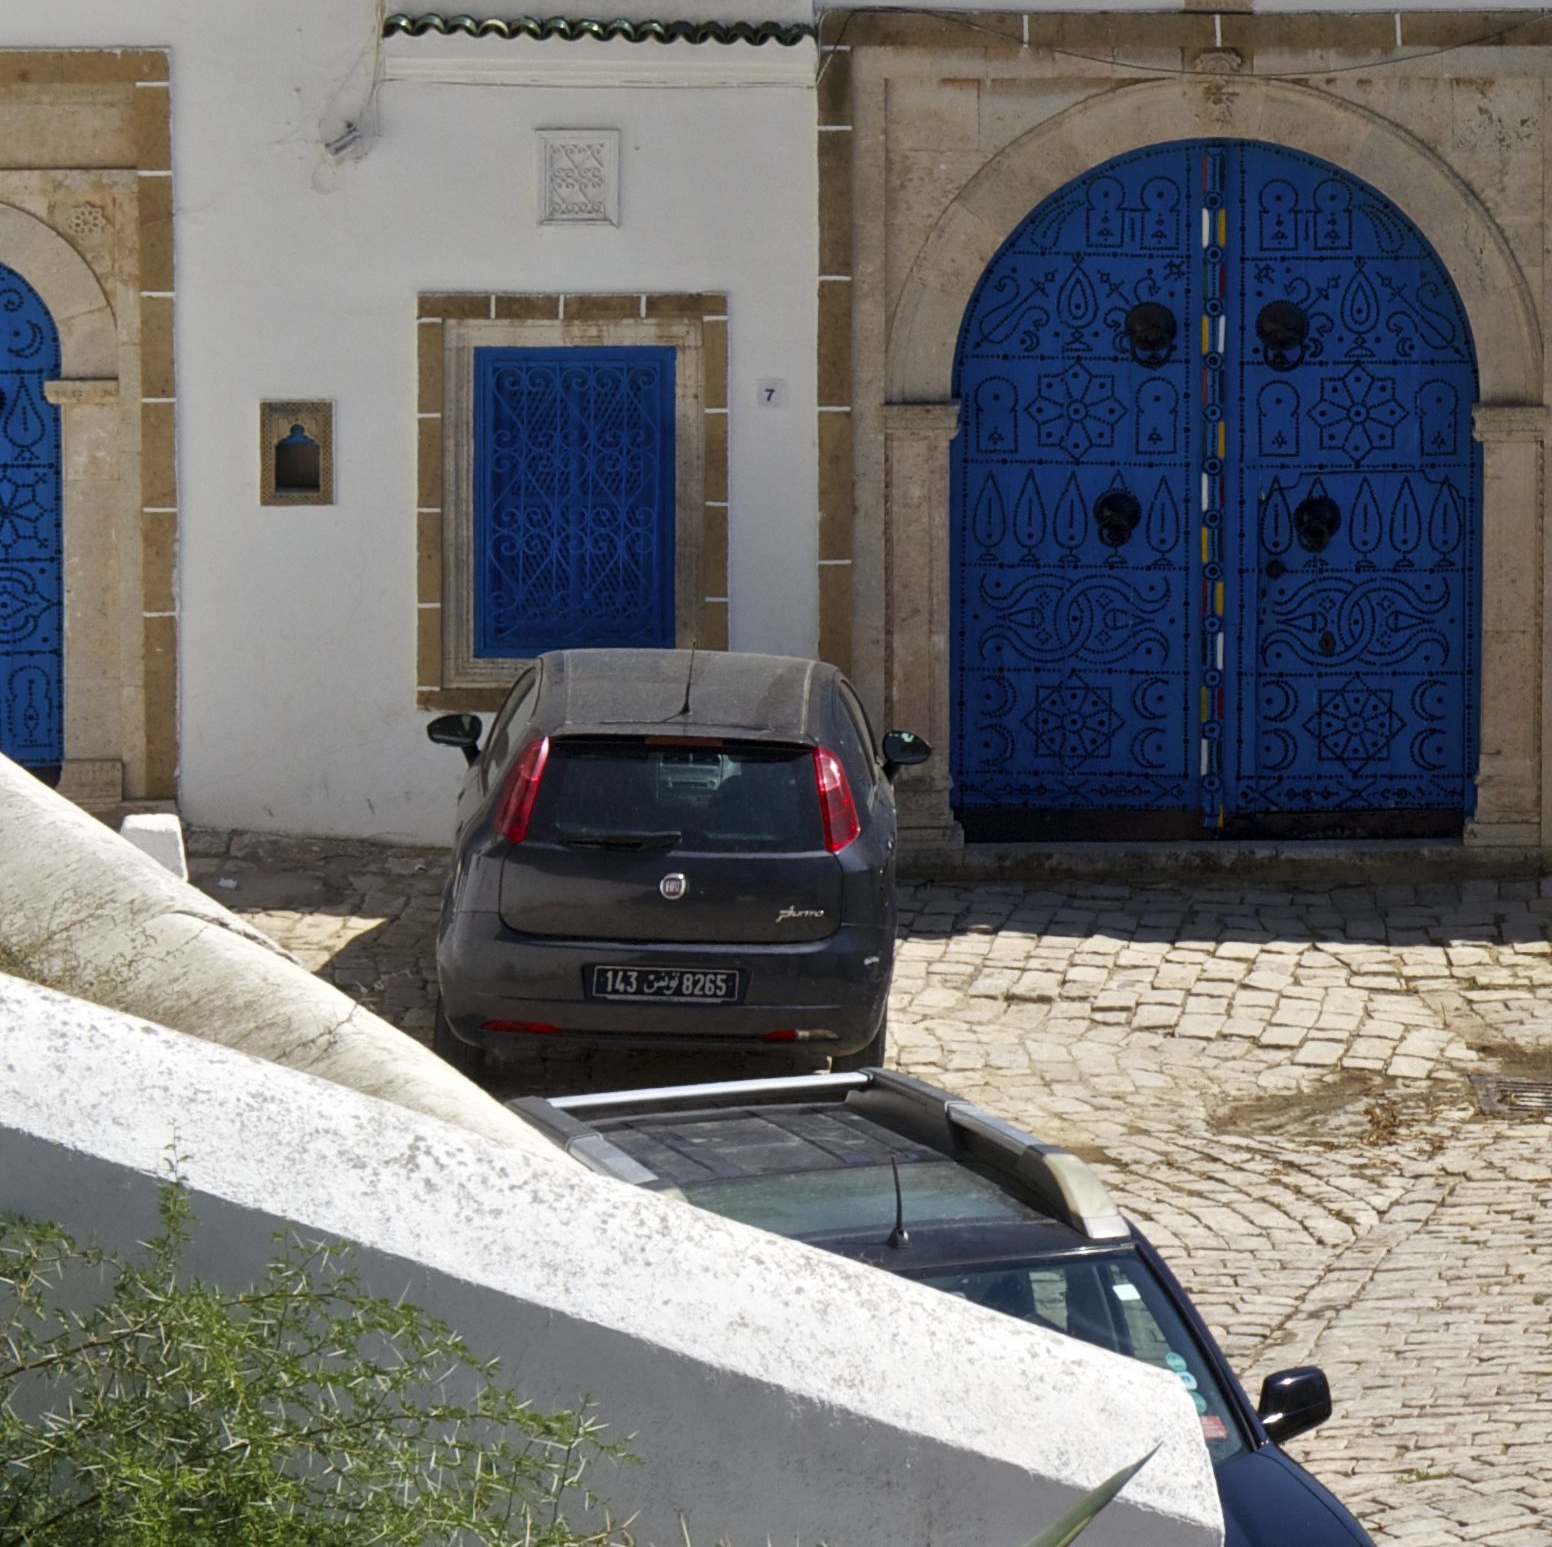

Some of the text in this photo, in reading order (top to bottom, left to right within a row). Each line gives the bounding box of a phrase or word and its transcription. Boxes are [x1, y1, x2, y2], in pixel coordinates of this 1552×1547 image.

[764, 388, 776, 402] 7
[606, 970, 728, 996] 143 تونس 8265
